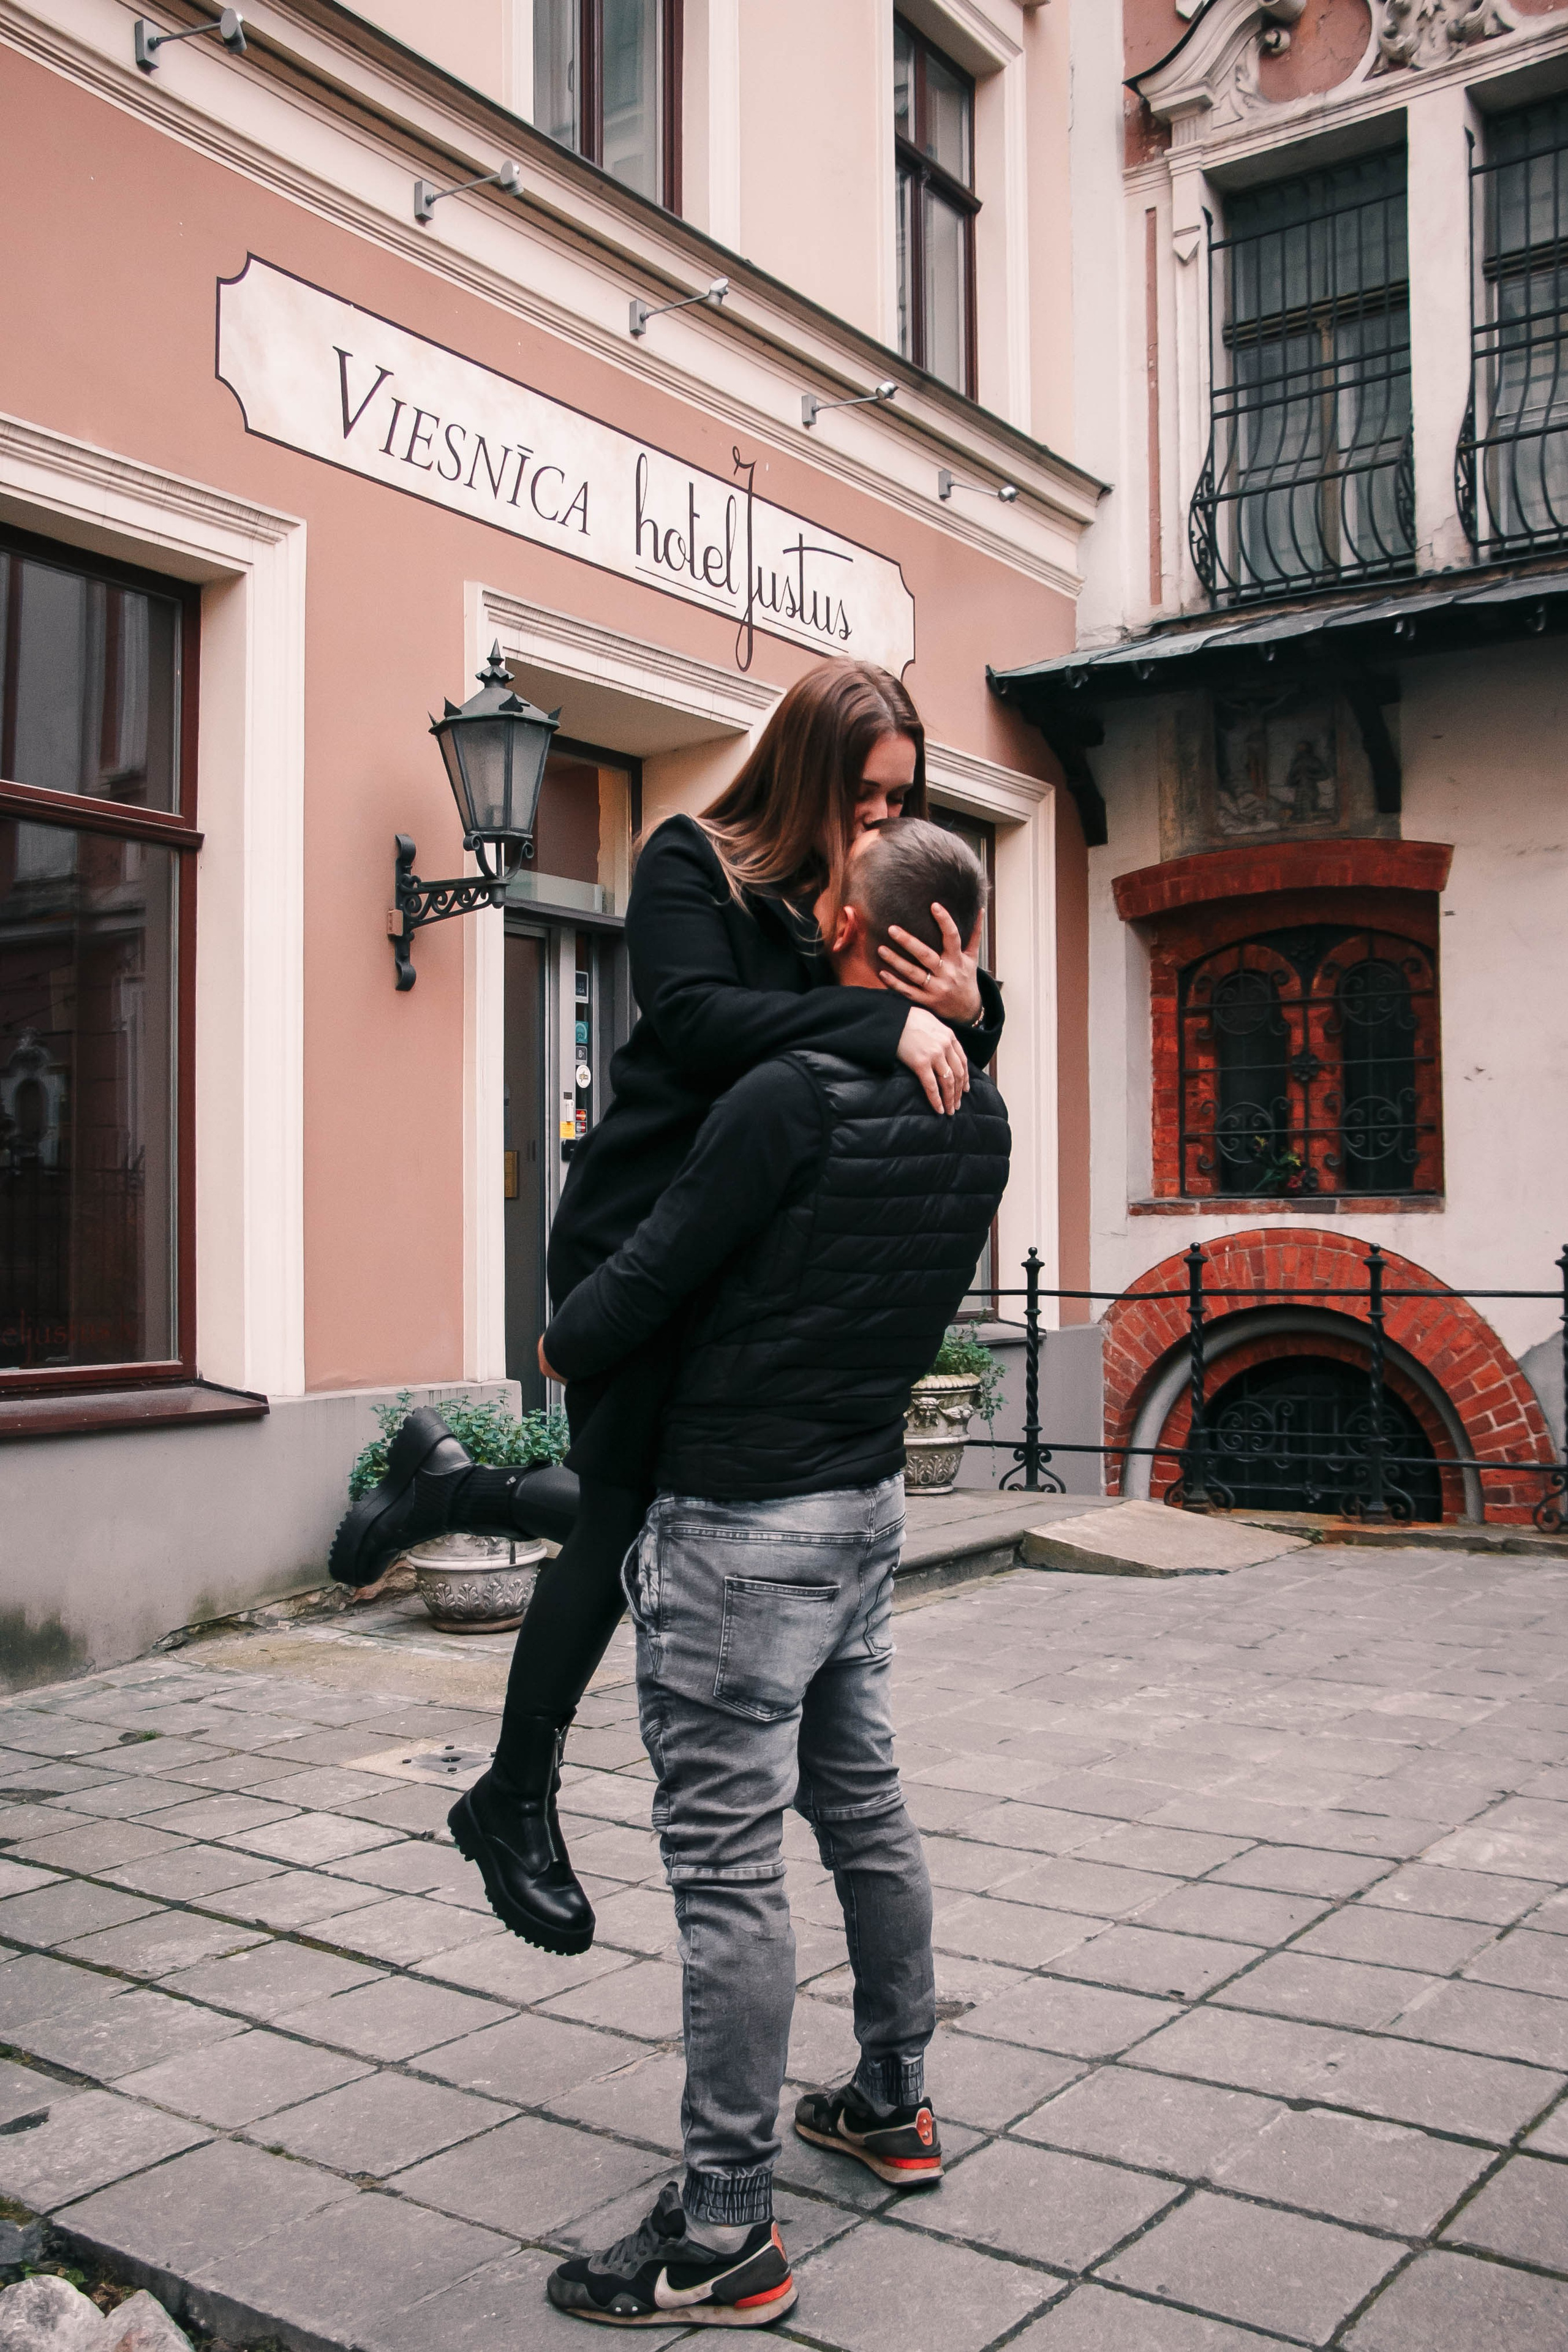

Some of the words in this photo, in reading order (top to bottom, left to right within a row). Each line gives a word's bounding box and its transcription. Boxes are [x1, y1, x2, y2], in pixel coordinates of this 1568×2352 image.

[333, 345, 591, 536] VIESNĪCA
[635, 452, 740, 595] hotel
[732, 445, 854, 673] Justus
